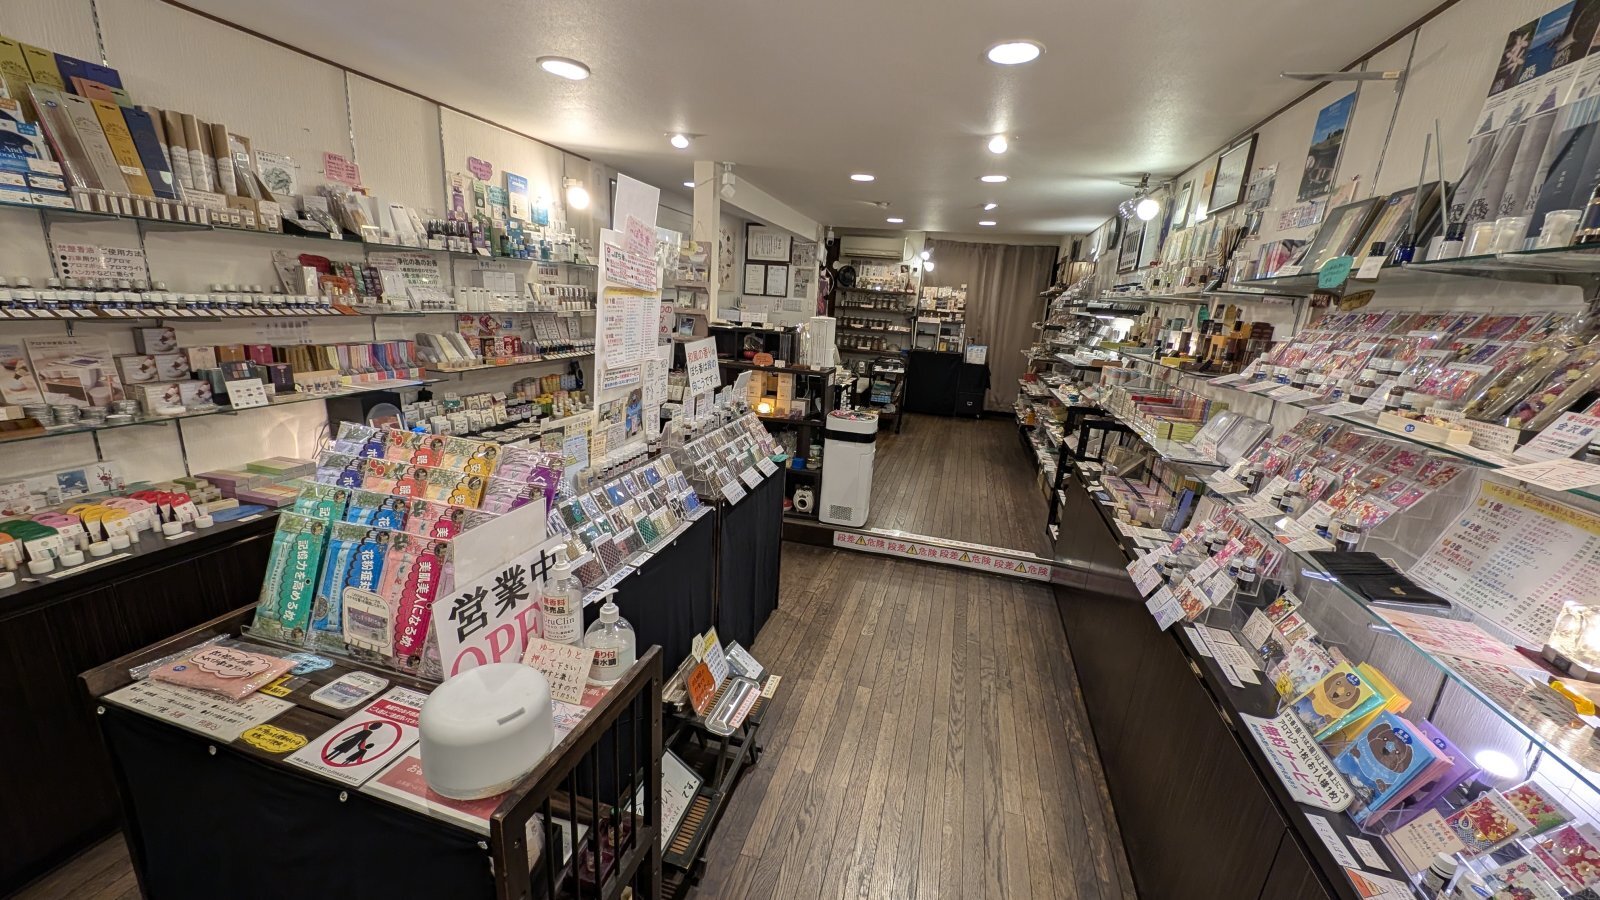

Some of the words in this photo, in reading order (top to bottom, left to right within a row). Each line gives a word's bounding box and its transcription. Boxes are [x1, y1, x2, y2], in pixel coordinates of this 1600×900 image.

[837, 533, 855, 544] 段差
[866, 537, 886, 549] 危険
[887, 543, 907, 553] 段差
[918, 548, 937, 558] 危険
[939, 549, 960, 561] 段差
[971, 555, 991, 566] 危険
[994, 560, 1015, 571] 段差
[1027, 565, 1049, 577] 危険
[281, 540, 308, 621] 記憶力を高める枕
[448, 549, 557, 644] 営業中
[544, 597, 566, 606] 無香料
[398, 561, 433, 651] 美肌美人になる枕
[544, 605, 566, 614] 非売品
[539, 643, 582, 660] ゆっくりと
